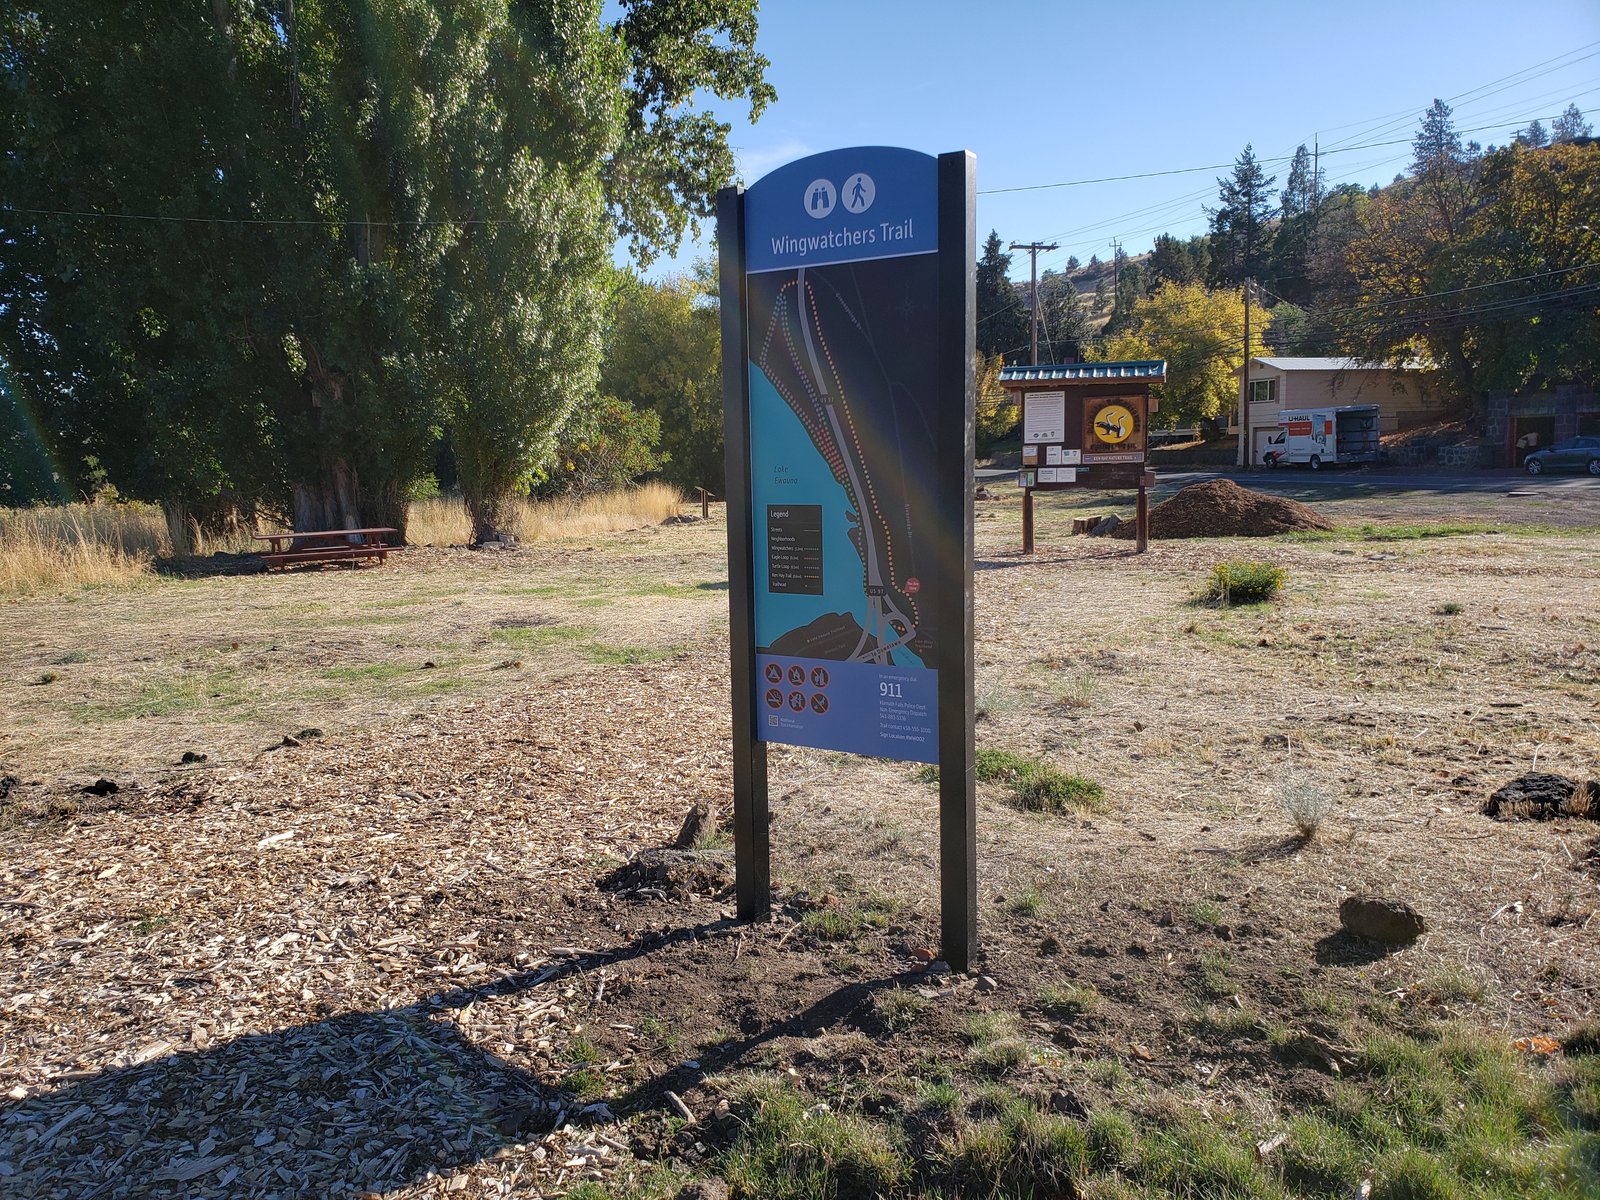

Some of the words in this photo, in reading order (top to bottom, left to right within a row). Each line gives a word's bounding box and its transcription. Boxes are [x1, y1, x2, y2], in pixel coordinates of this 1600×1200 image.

[771, 227, 876, 257] Wingwatchers
[880, 218, 914, 242] Trail
[774, 465, 788, 473] Lake
[770, 510, 789, 519] Legend
[880, 682, 902, 698] 911
